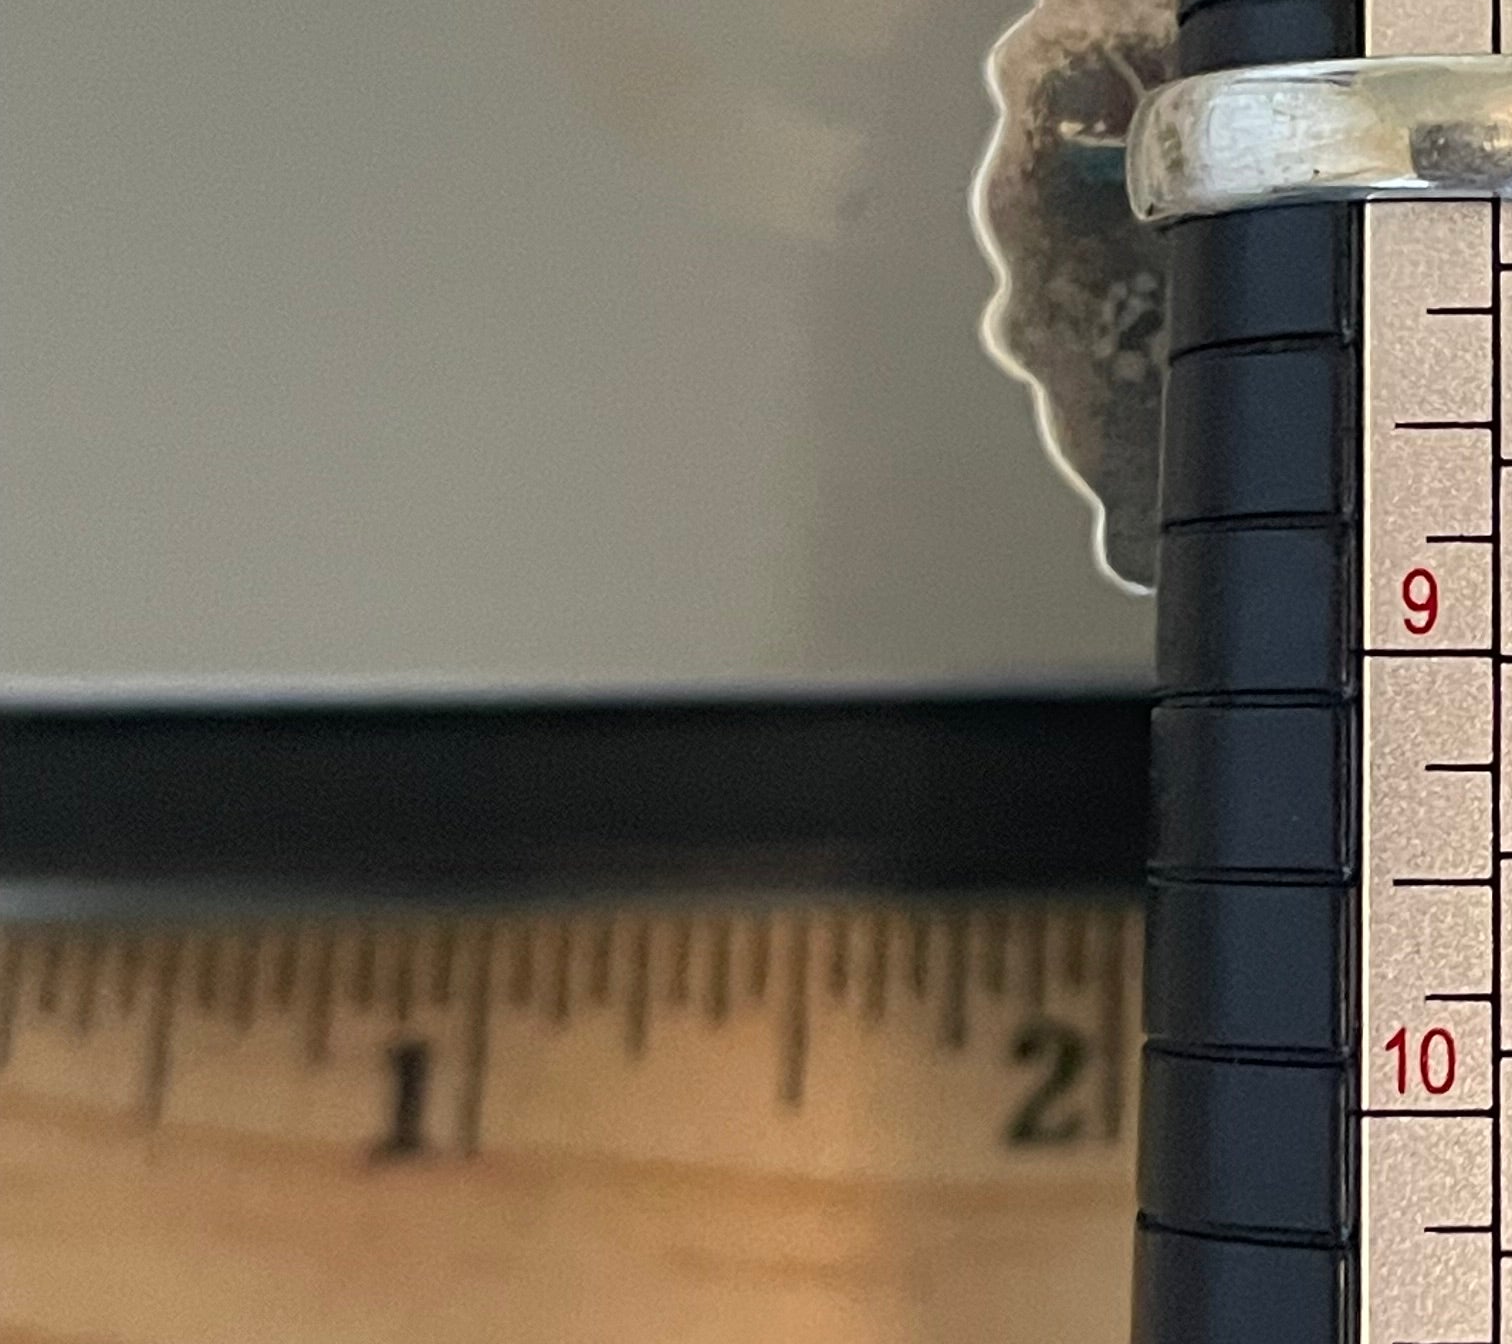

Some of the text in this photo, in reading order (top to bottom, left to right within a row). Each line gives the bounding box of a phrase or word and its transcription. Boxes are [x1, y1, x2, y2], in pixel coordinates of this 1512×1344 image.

[1399, 564, 1441, 637] 9
[360, 1036, 438, 1162] 1
[1007, 1014, 1090, 1148] 2
[1383, 1023, 1460, 1097] 10
